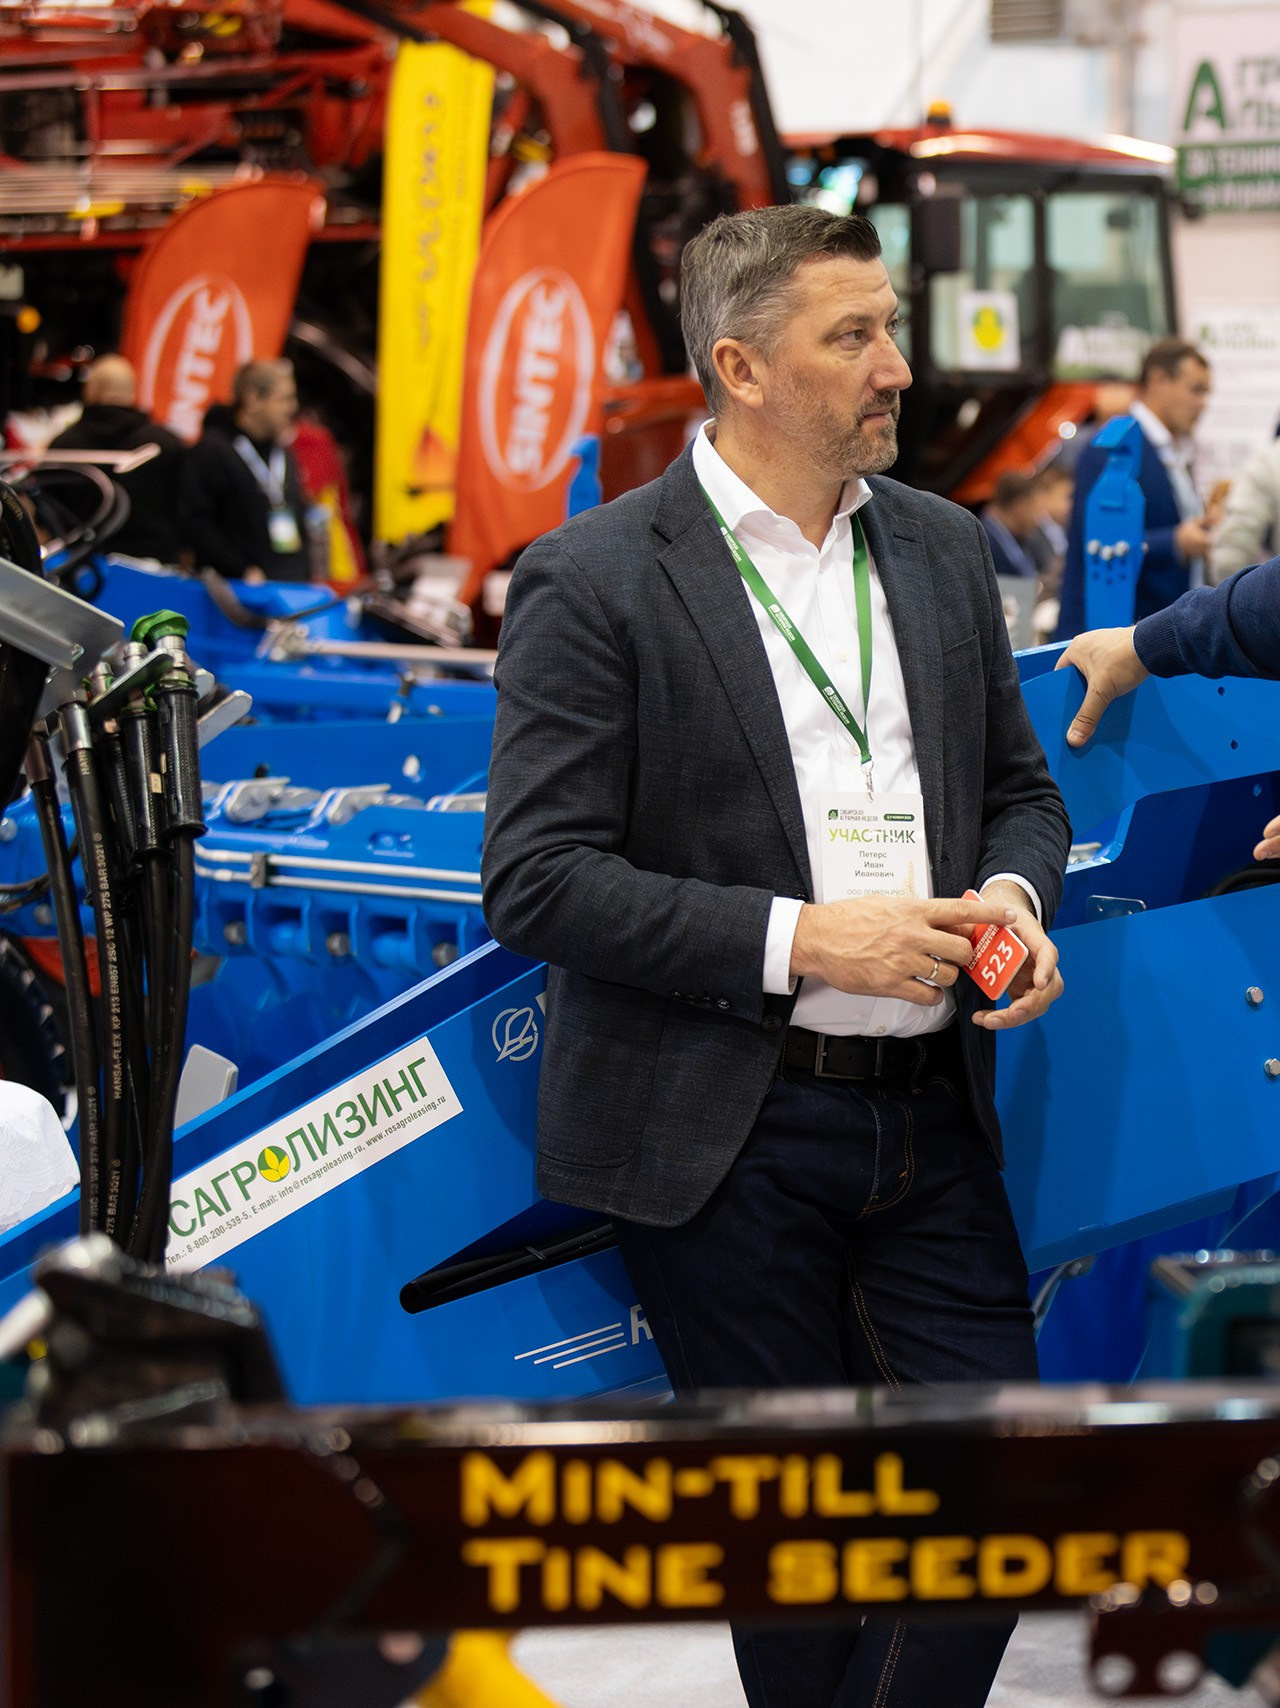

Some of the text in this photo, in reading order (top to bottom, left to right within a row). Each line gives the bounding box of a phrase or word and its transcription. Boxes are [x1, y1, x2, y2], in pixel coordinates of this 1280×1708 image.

[165, 287, 231, 443] INTEC
[506, 282, 571, 473] SINTEC
[828, 828, 916, 844] УЧАСТНИК
[859, 851, 887, 860] Петерс
[855, 870, 894, 878] Иванович
[864, 861, 884, 869] Иван
[102, 891, 112, 909] 275
[104, 911, 114, 928] WP
[981, 940, 1013, 986] 523
[113, 1033, 122, 1099] HANSA-FLEX
[167, 1056, 427, 1238] САГРОЛИЗИНГ
[252, 1194, 279, 1215] E-mail:
[365, 1095, 447, 1148] www.rosagroleasing.ru
[461, 1450, 938, 1526] MIN-TILL
[462, 1530, 1190, 1613] TINE SEEDER
